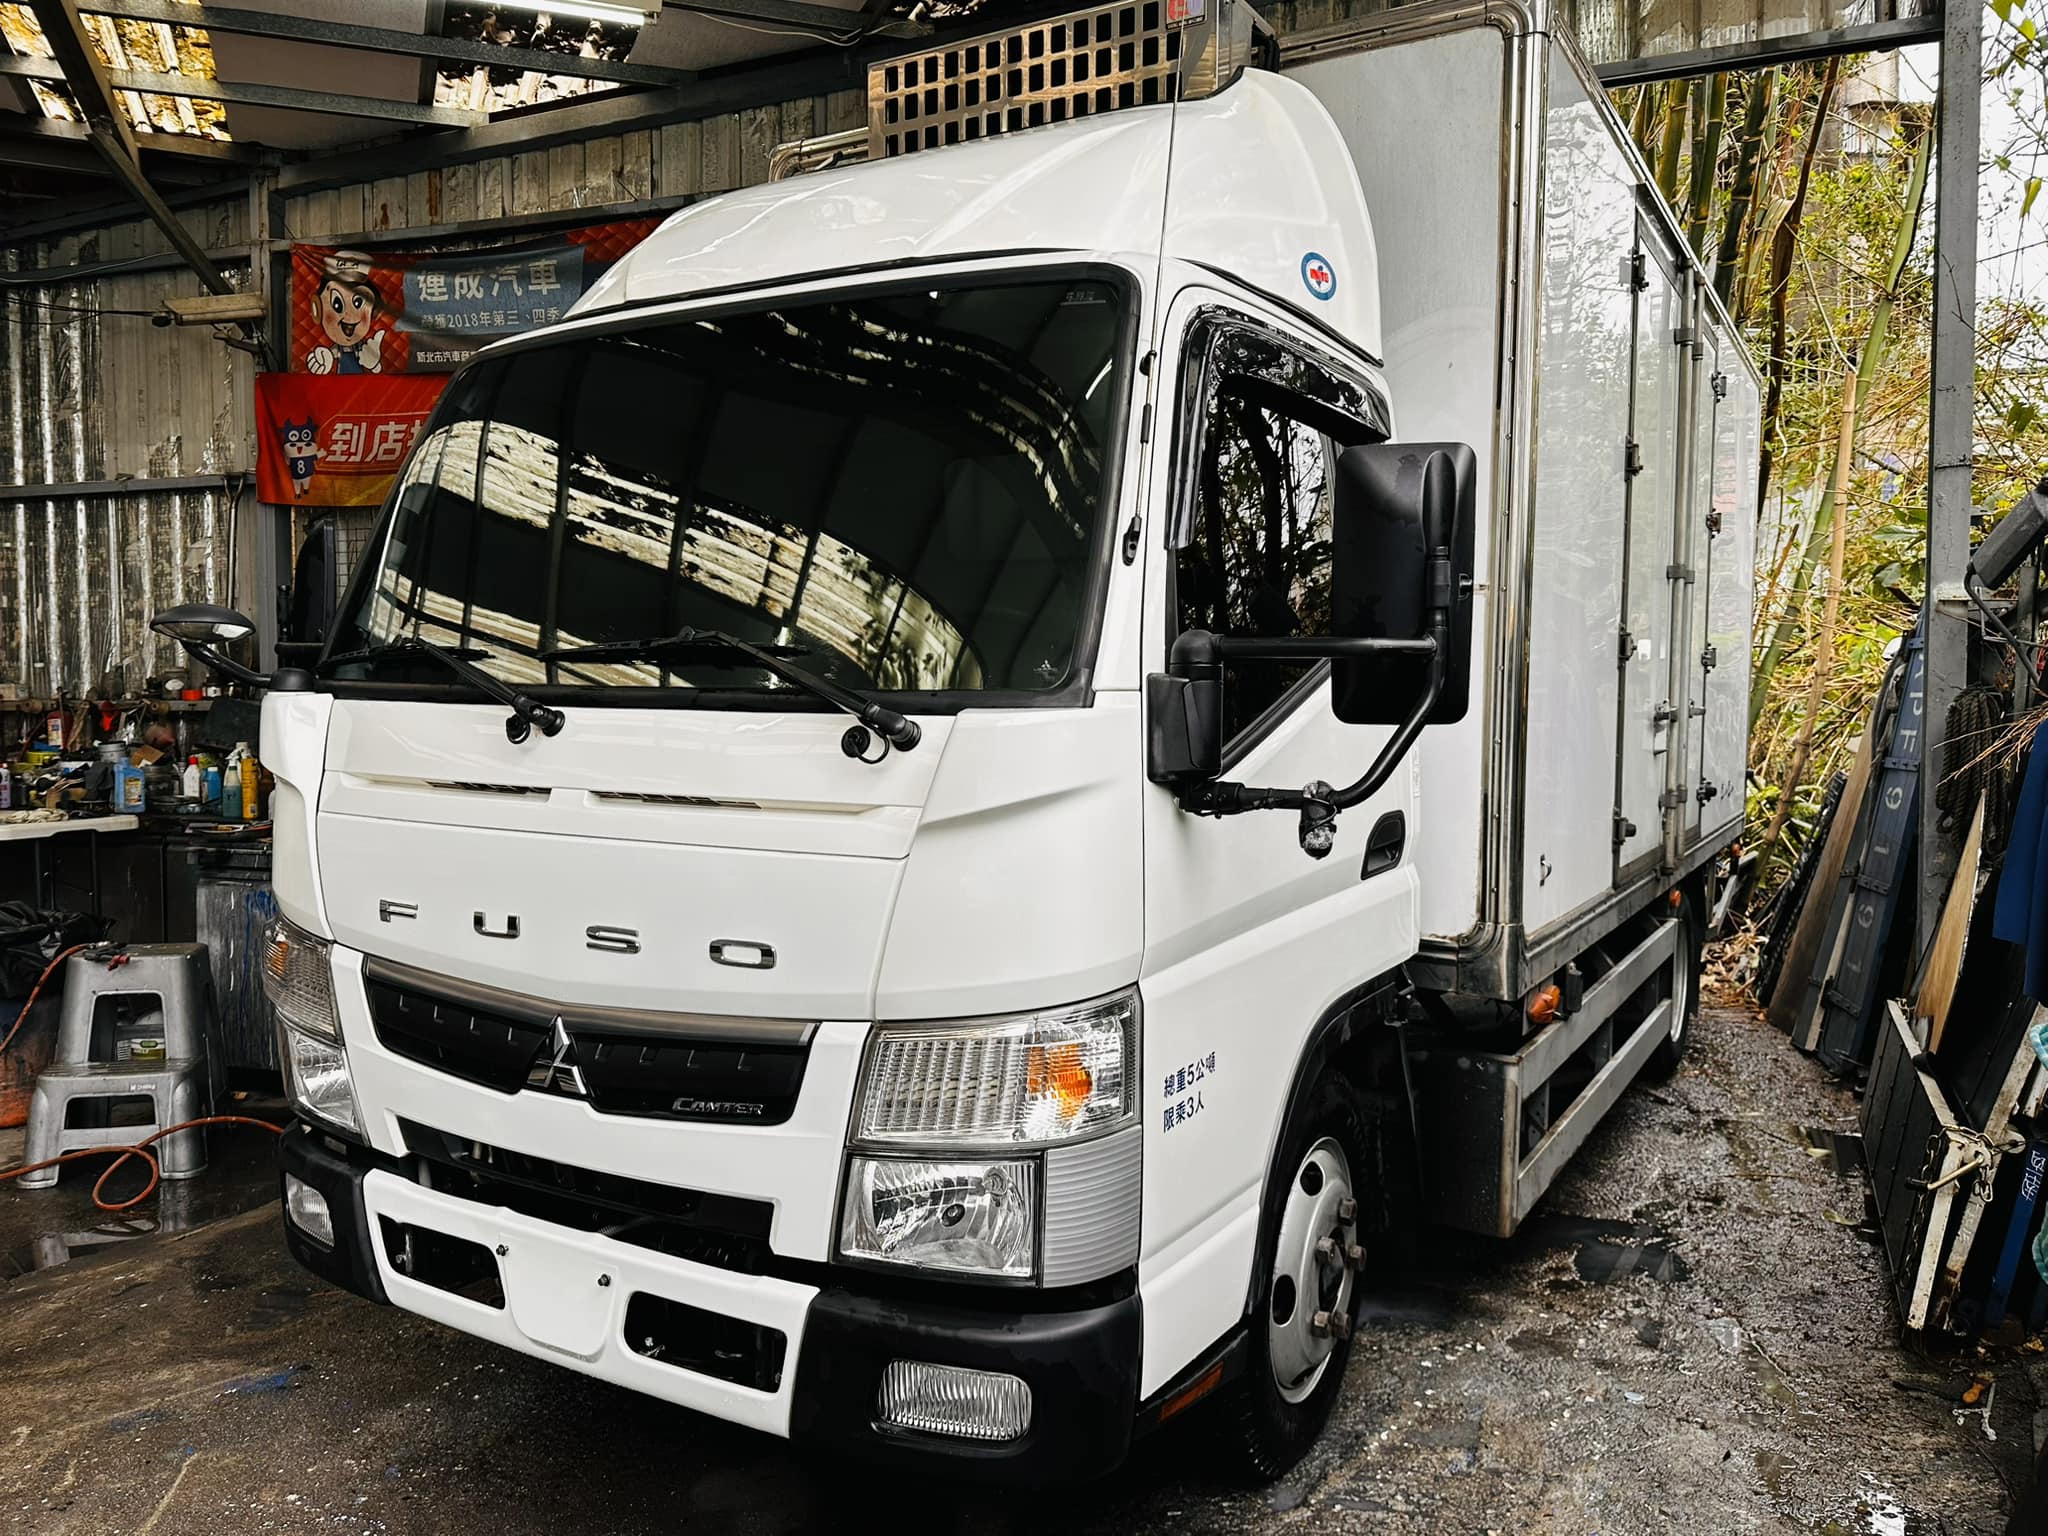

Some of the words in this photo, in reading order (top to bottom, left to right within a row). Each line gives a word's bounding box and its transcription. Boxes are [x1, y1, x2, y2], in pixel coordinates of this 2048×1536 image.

[417, 258, 561, 302] 建成汽車
[379, 898, 777, 970] FUSO
[1163, 1051, 1217, 1099] 總重5公噸
[672, 1097, 764, 1116] CANTER
[1163, 1091, 1205, 1134] 限乘3人
